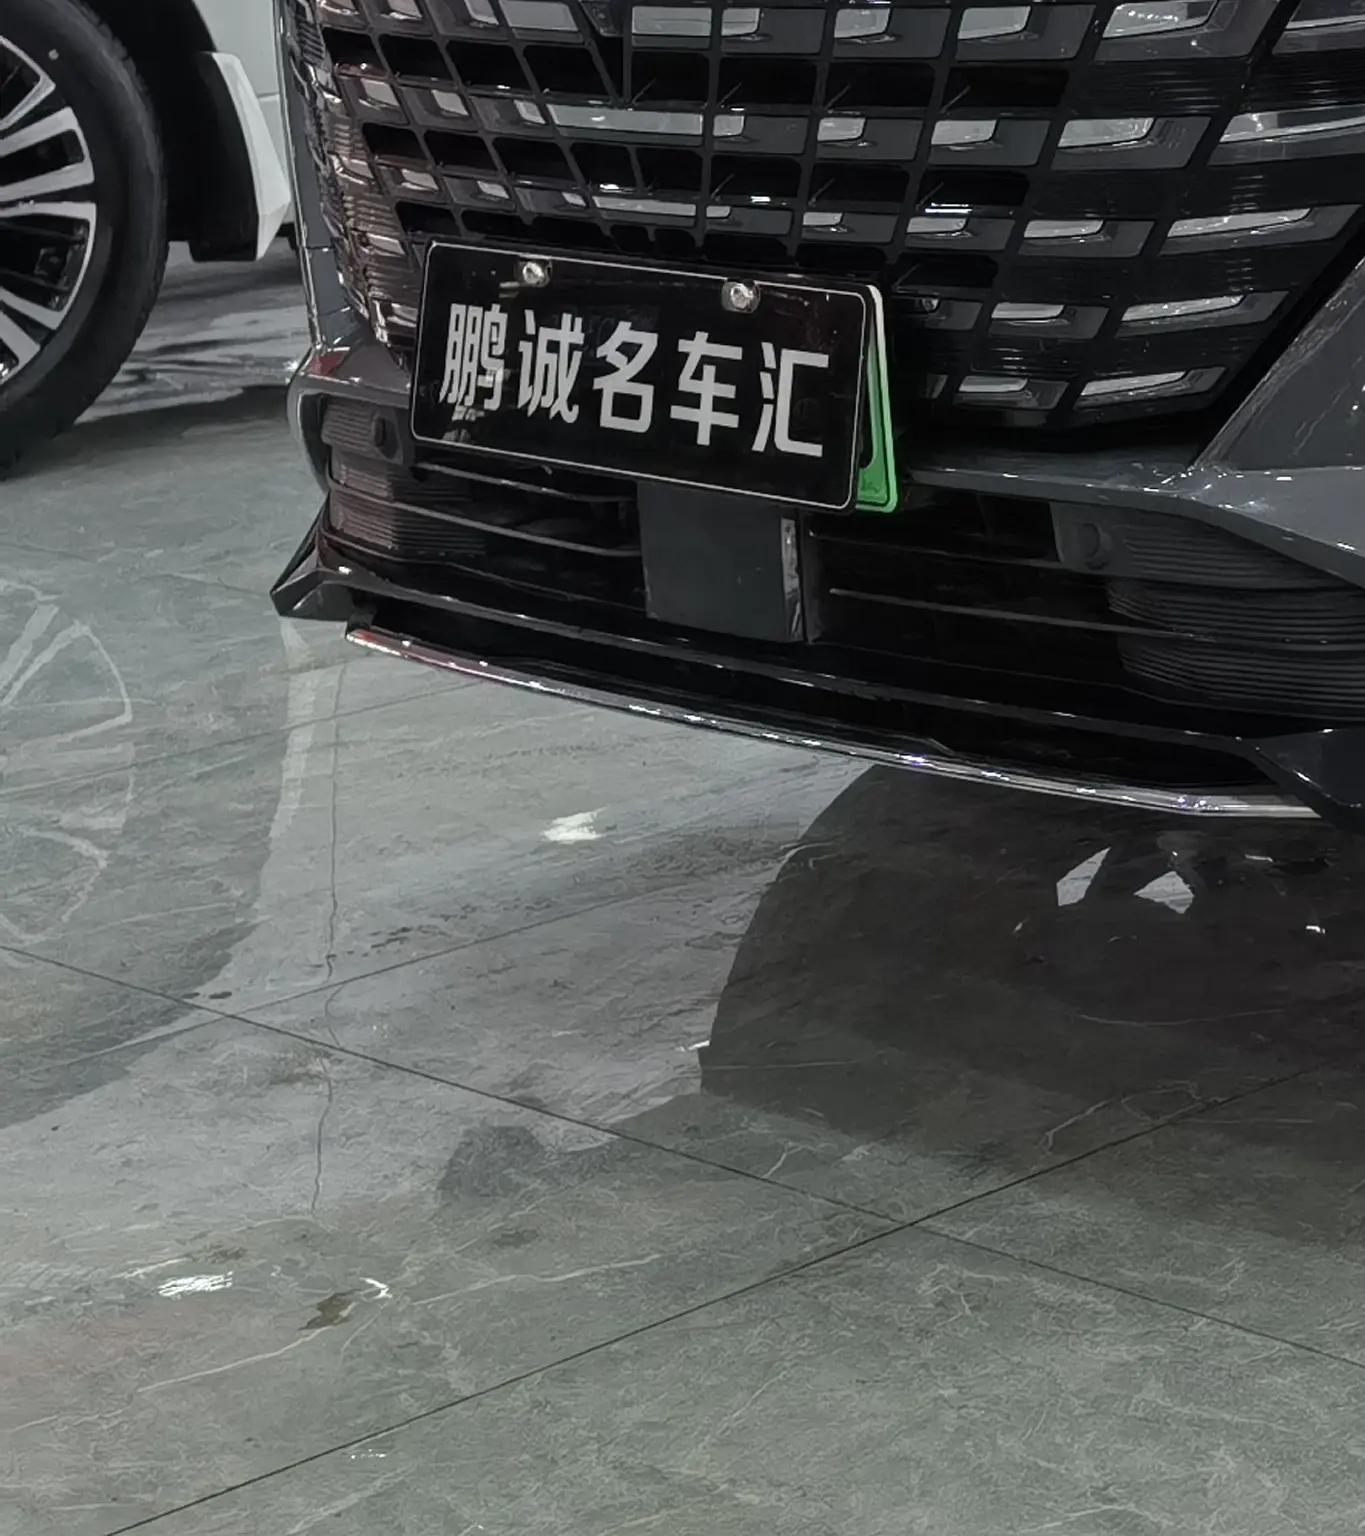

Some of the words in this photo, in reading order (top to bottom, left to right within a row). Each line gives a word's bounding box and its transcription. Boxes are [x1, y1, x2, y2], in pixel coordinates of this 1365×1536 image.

[438, 303, 830, 458] 鹏诚名车汇
